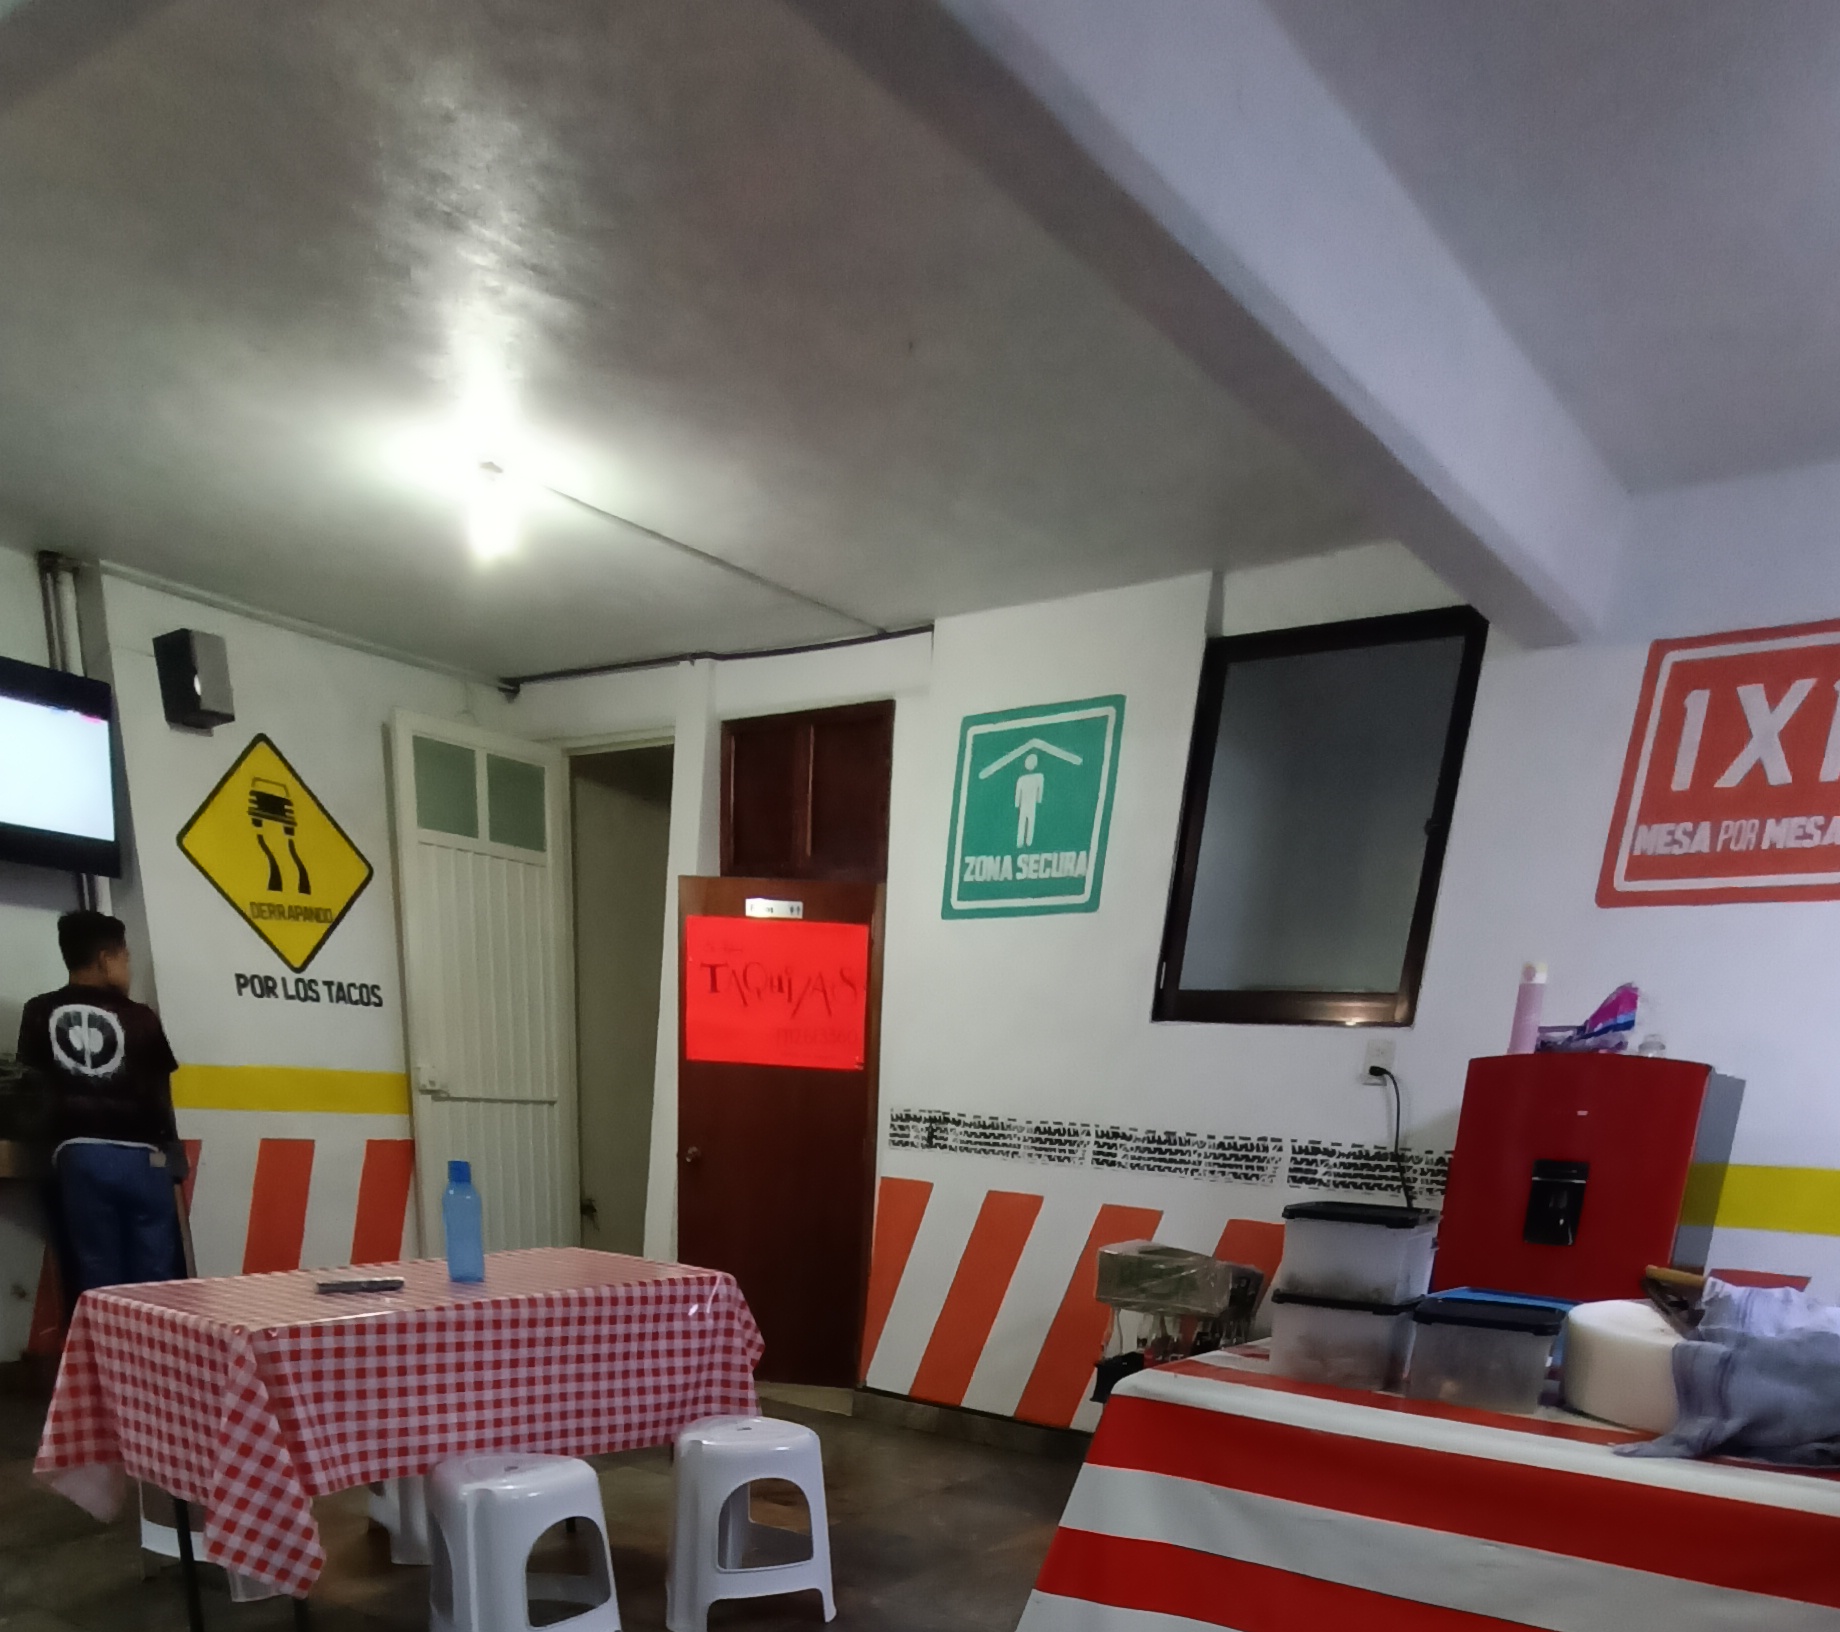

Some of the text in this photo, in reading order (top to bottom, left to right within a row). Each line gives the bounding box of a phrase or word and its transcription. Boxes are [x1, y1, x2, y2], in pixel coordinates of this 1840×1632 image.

[1633, 815, 1840, 856] MESA POR MESA
[963, 850, 1088, 882] ZONA SEGURA
[250, 902, 333, 923] DERRAPANDO
[234, 973, 383, 1008] POR LOS TACOS
